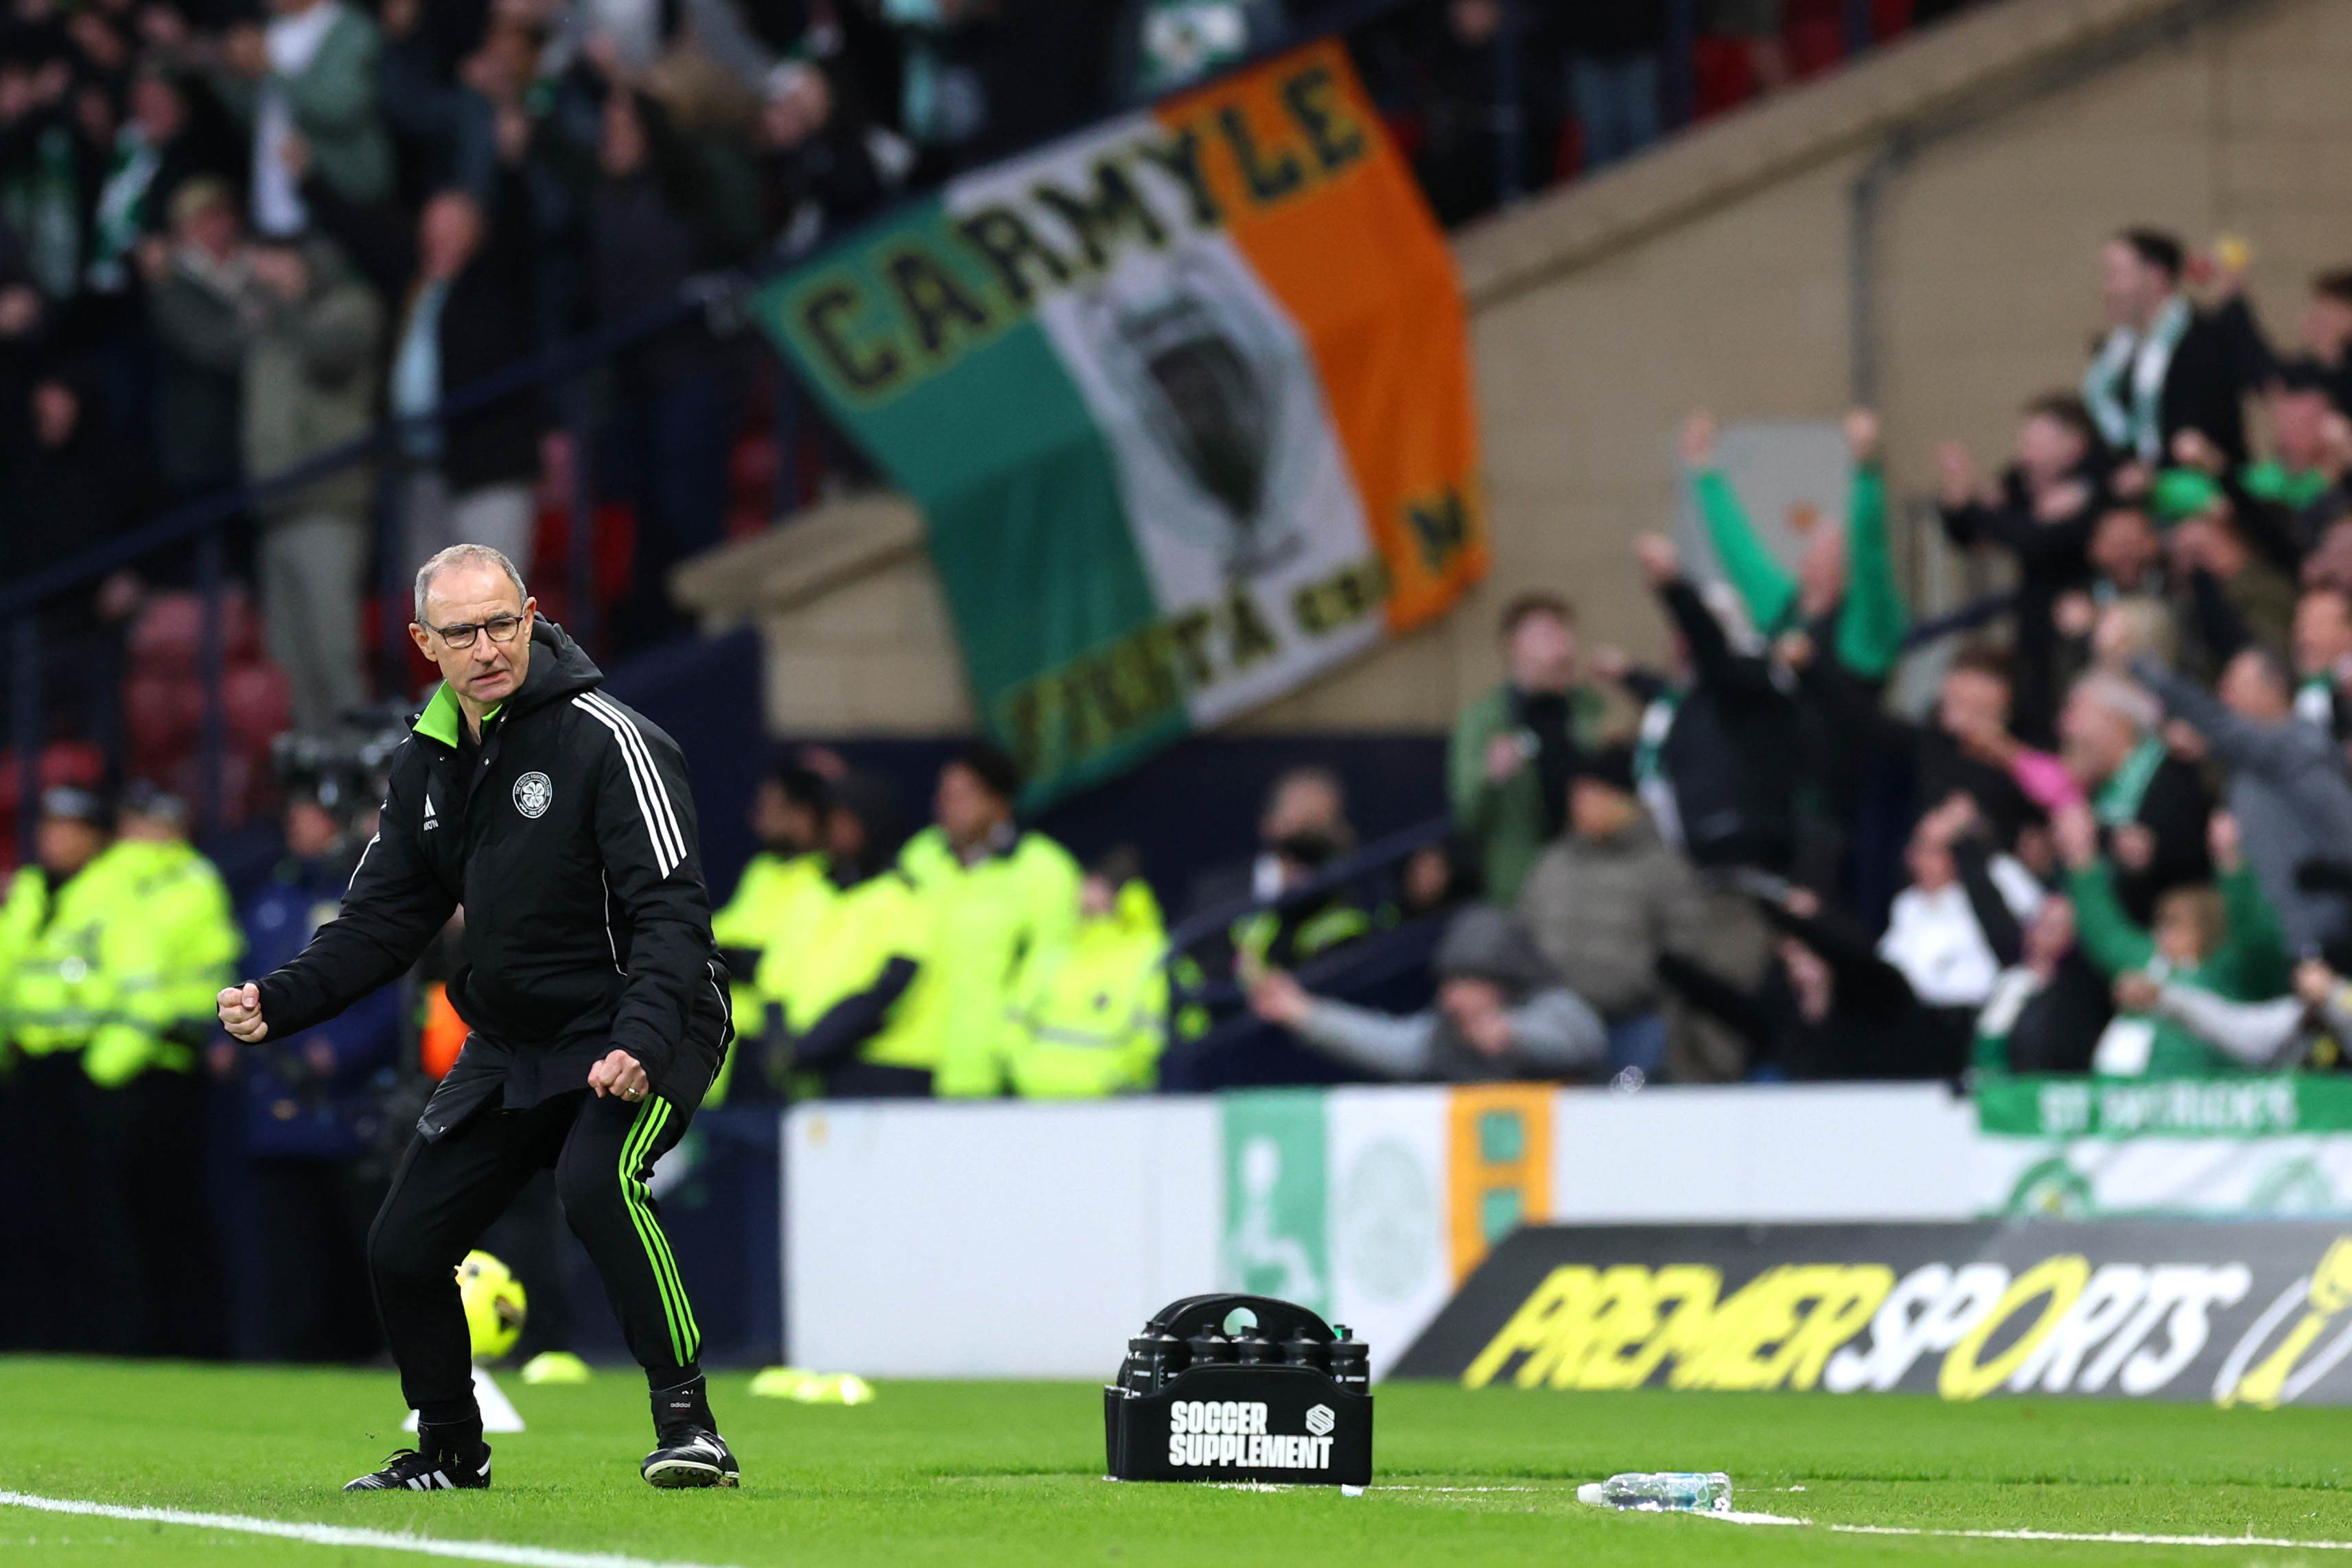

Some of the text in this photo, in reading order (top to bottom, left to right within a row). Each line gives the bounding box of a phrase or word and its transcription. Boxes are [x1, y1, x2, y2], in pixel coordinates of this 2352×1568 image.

[795, 65, 1367, 393] CARMYLE
[1461, 1254, 2252, 1401] PREMIER SPORTS
[1168, 1434, 1334, 1469] SUPPLEMENT
[1170, 1400, 1268, 1435] SOCCER
